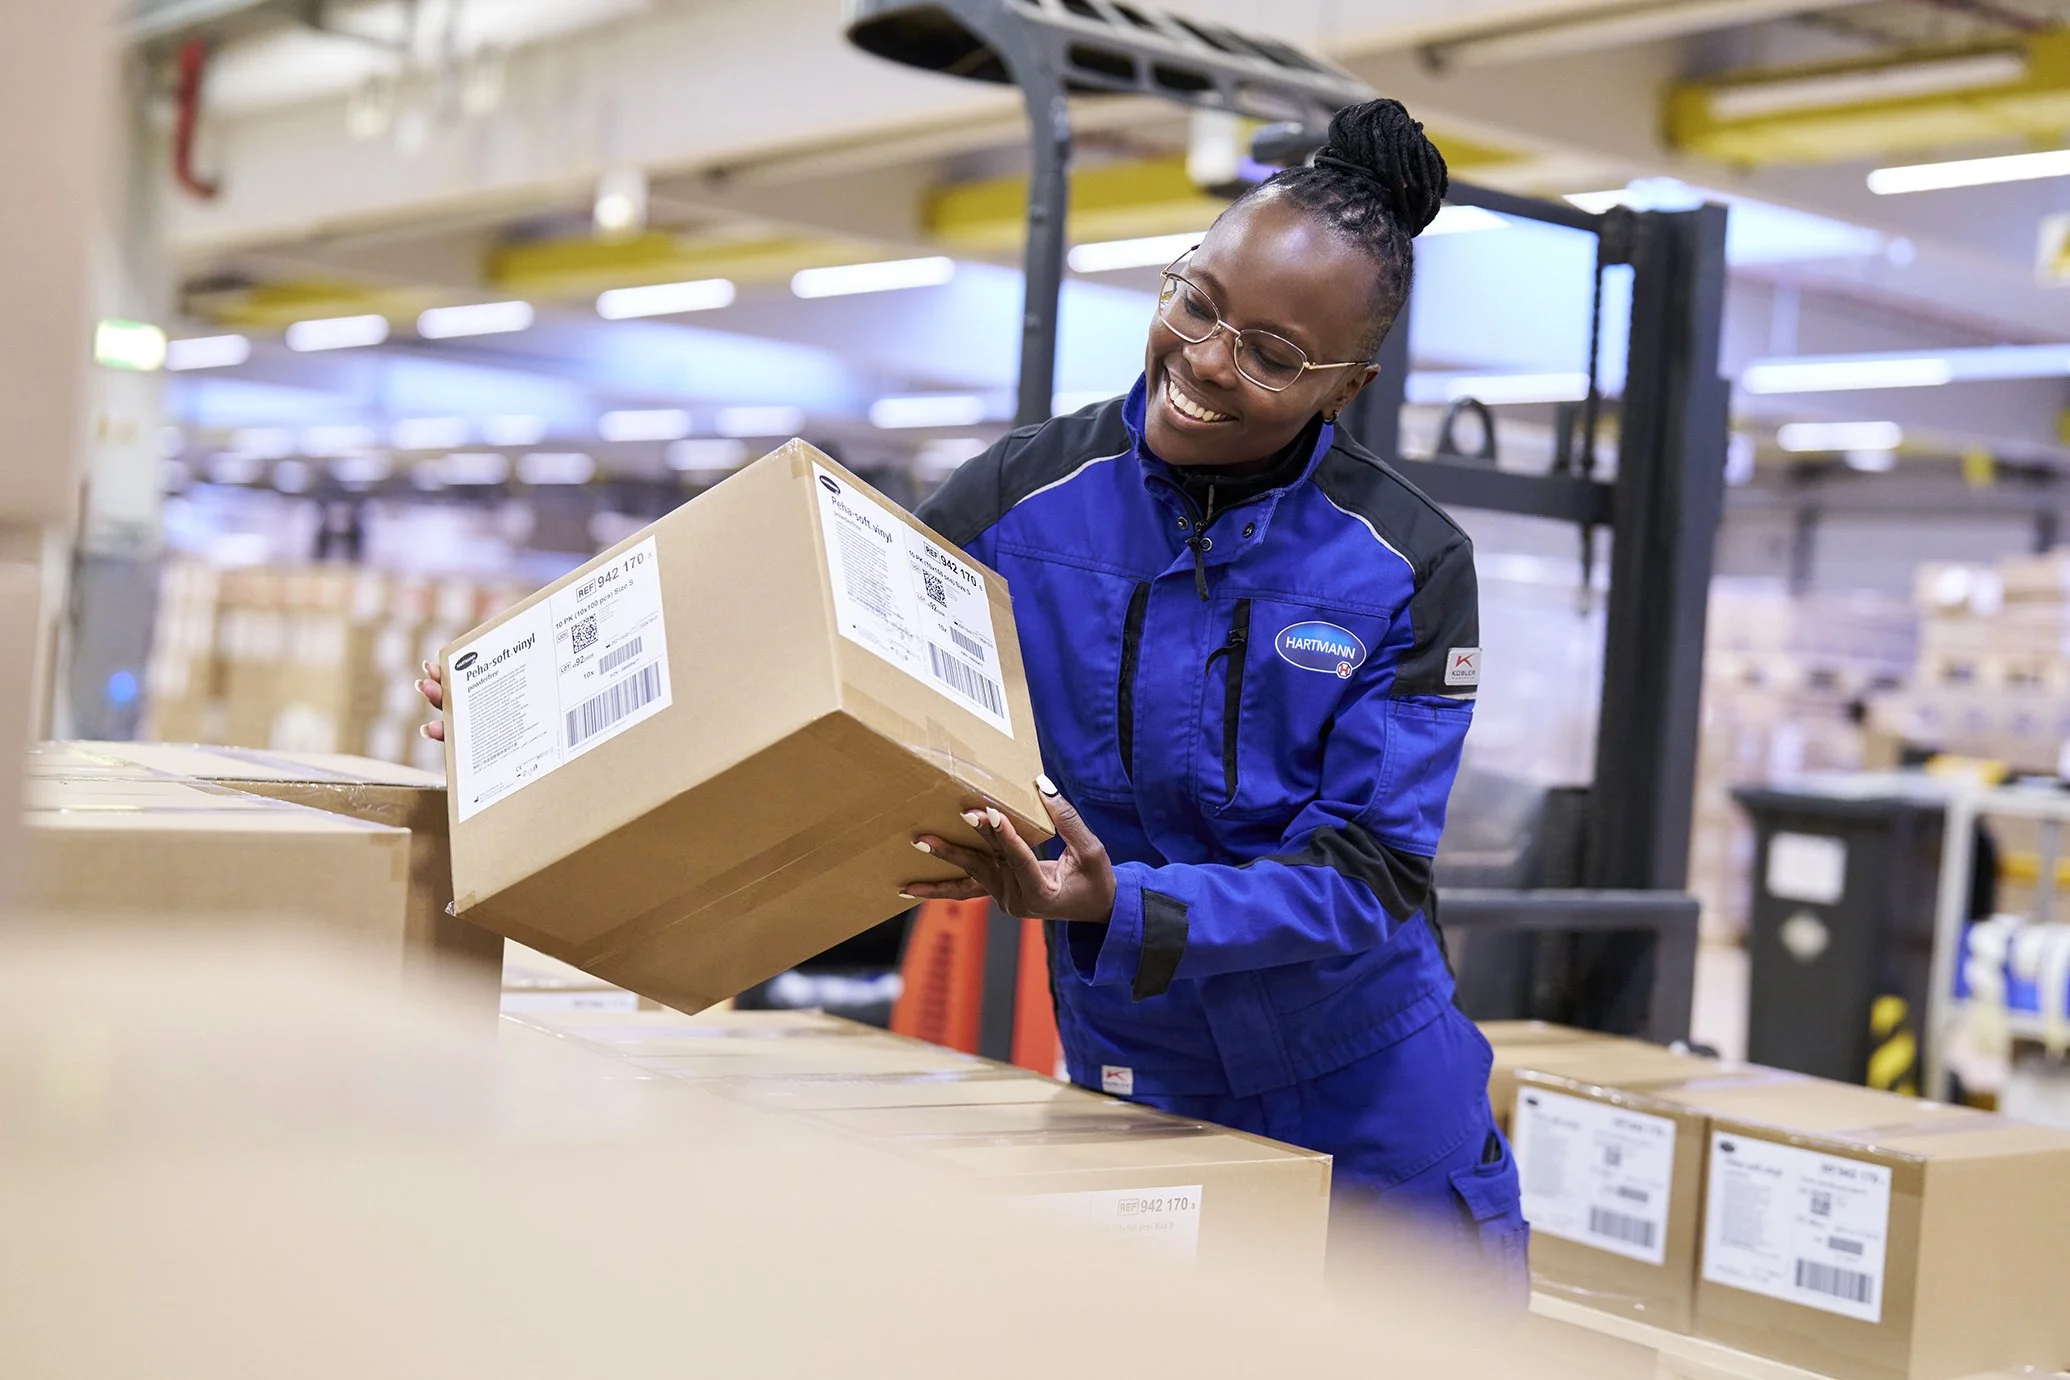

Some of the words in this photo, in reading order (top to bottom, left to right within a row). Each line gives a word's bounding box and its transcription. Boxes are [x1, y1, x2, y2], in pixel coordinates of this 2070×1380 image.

[832, 496, 872, 530] Peha-soft
[872, 525, 893, 544] vinyl
[597, 567, 620, 588] 942
[623, 552, 645, 572] 170
[940, 554, 959, 575] 942
[960, 568, 977, 587] 170
[555, 621, 563, 630] 10
[563, 614, 574, 625] PK
[574, 599, 599, 620] (10x100
[614, 583, 629, 595] Size
[466, 648, 511, 681] Peha-soft
[512, 632, 536, 654] vinyl
[1285, 636, 1356, 660] HARTMANN
[467, 670, 499, 693] powderfree
[583, 670, 594, 680] 10x
[1140, 1198, 1163, 1213] 942
[1167, 1197, 1188, 1212] 170
